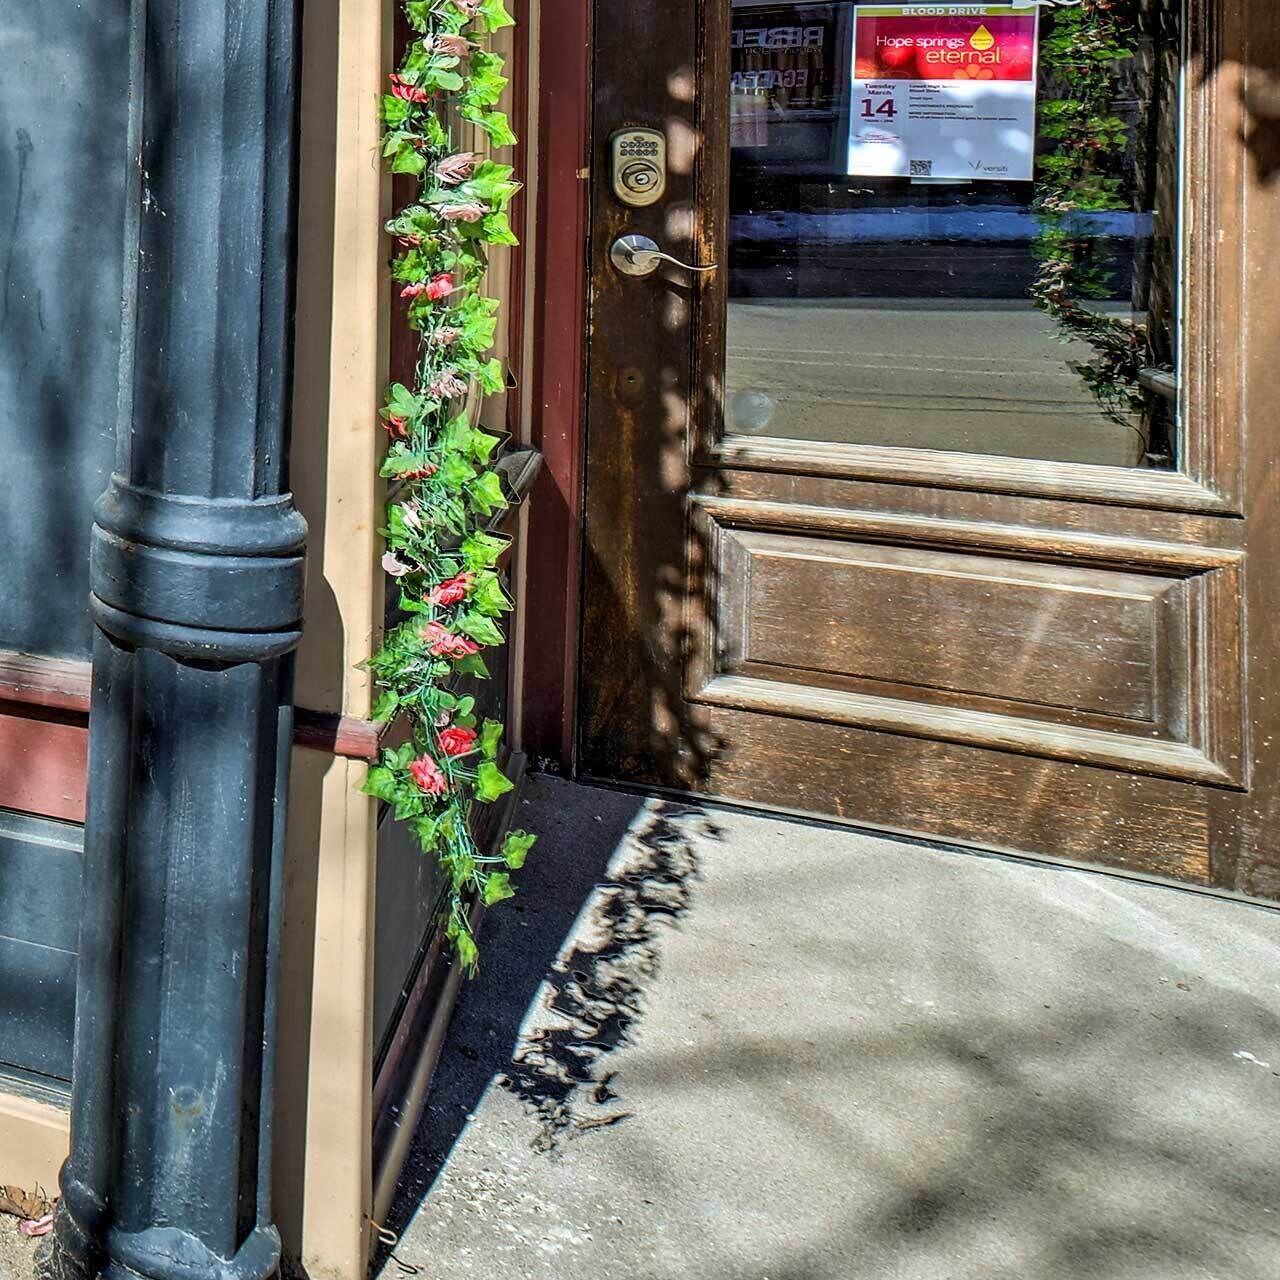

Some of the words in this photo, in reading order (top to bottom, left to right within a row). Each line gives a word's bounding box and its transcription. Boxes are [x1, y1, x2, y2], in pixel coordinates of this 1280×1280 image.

[902, 7, 945, 16] BLOOD
[948, 7, 988, 15] DRIVE
[876, 35, 913, 48] Hope
[916, 35, 966, 49] springs
[925, 47, 1001, 64] eternal
[861, 98, 898, 118] 14
